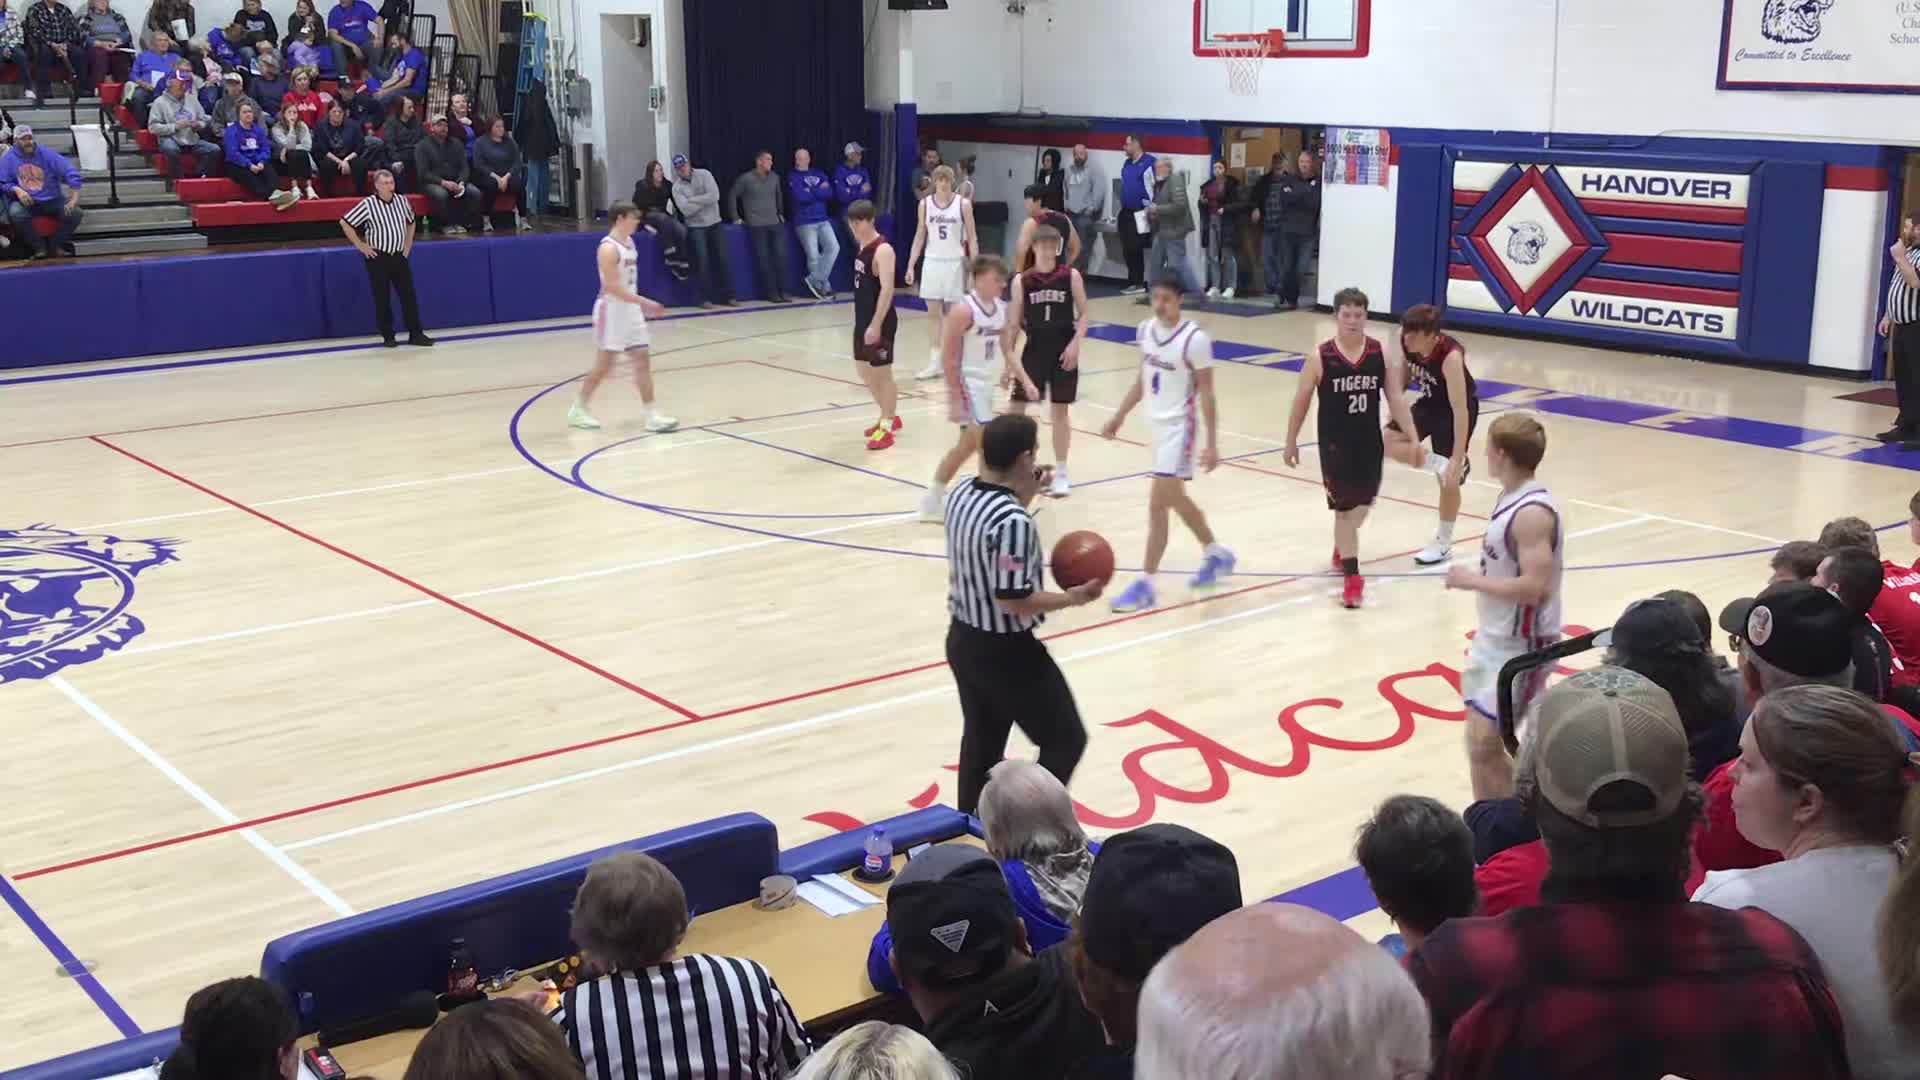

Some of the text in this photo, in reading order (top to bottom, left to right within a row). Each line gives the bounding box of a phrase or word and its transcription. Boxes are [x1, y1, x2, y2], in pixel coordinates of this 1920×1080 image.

[1735, 48, 1852, 62] Committed to Excellence
[1581, 173, 1732, 200] HANOVER
[938, 225, 948, 241] 5
[1029, 289, 1067, 304] TIGERS
[1571, 298, 1724, 333] WILDCATS
[1332, 375, 1379, 393] TIGERS
[1348, 393, 1368, 414] 20
